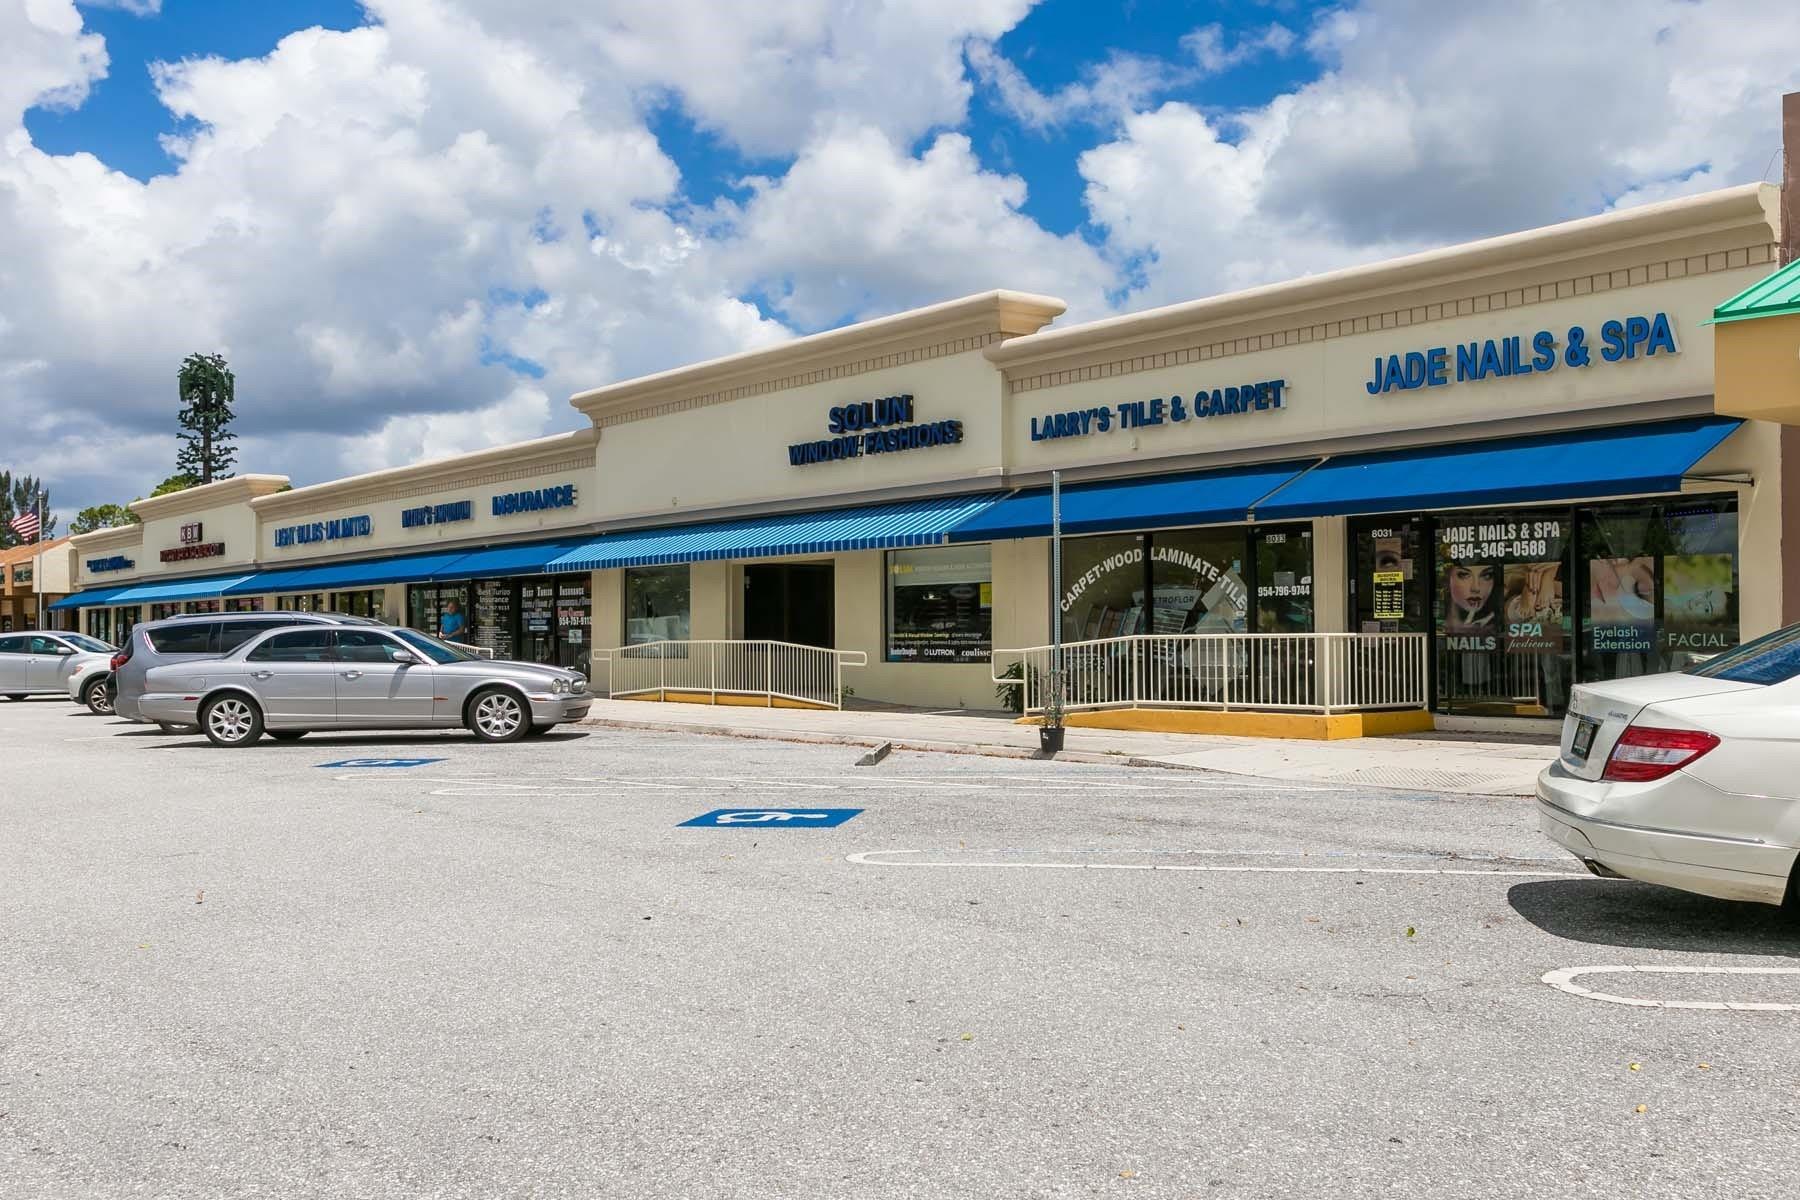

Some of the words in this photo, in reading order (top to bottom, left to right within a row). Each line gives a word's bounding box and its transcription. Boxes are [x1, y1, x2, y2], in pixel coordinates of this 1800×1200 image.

[1367, 348, 1447, 394] JADE
[1457, 332, 1555, 381] NAILS
[1565, 327, 1590, 367] &
[1601, 313, 1677, 361] SPA
[829, 395, 913, 433] SOLUN
[1031, 407, 1110, 441] LARRY'S
[1118, 399, 1163, 428] TILE
[1170, 396, 1186, 421] &
[1195, 380, 1284, 417] CARPET
[789, 436, 858, 465] WINDOW
[865, 420, 963, 454] FASHIONS
[492, 485, 573, 515] INSURANCE
[275, 527, 296, 547] LIGHT
[326, 515, 371, 539] UNLIMITED
[1372, 529, 1392, 538] 8031
[1442, 526, 1475, 543] JADE
[1479, 524, 1516, 541] NAILS
[1521, 523, 1529, 539] &
[1534, 521, 1560, 538] SPA
[1450, 540, 1546, 559] 954-346-0588
[1257, 585, 1310, 597] 954-796-9744
[1508, 624, 1542, 637] SPA
[1593, 626, 1638, 638] Eyelash
[1668, 633, 1728, 647] FACIAL
[1447, 637, 1496, 650] NAILS
[1593, 639, 1650, 650] Extension
